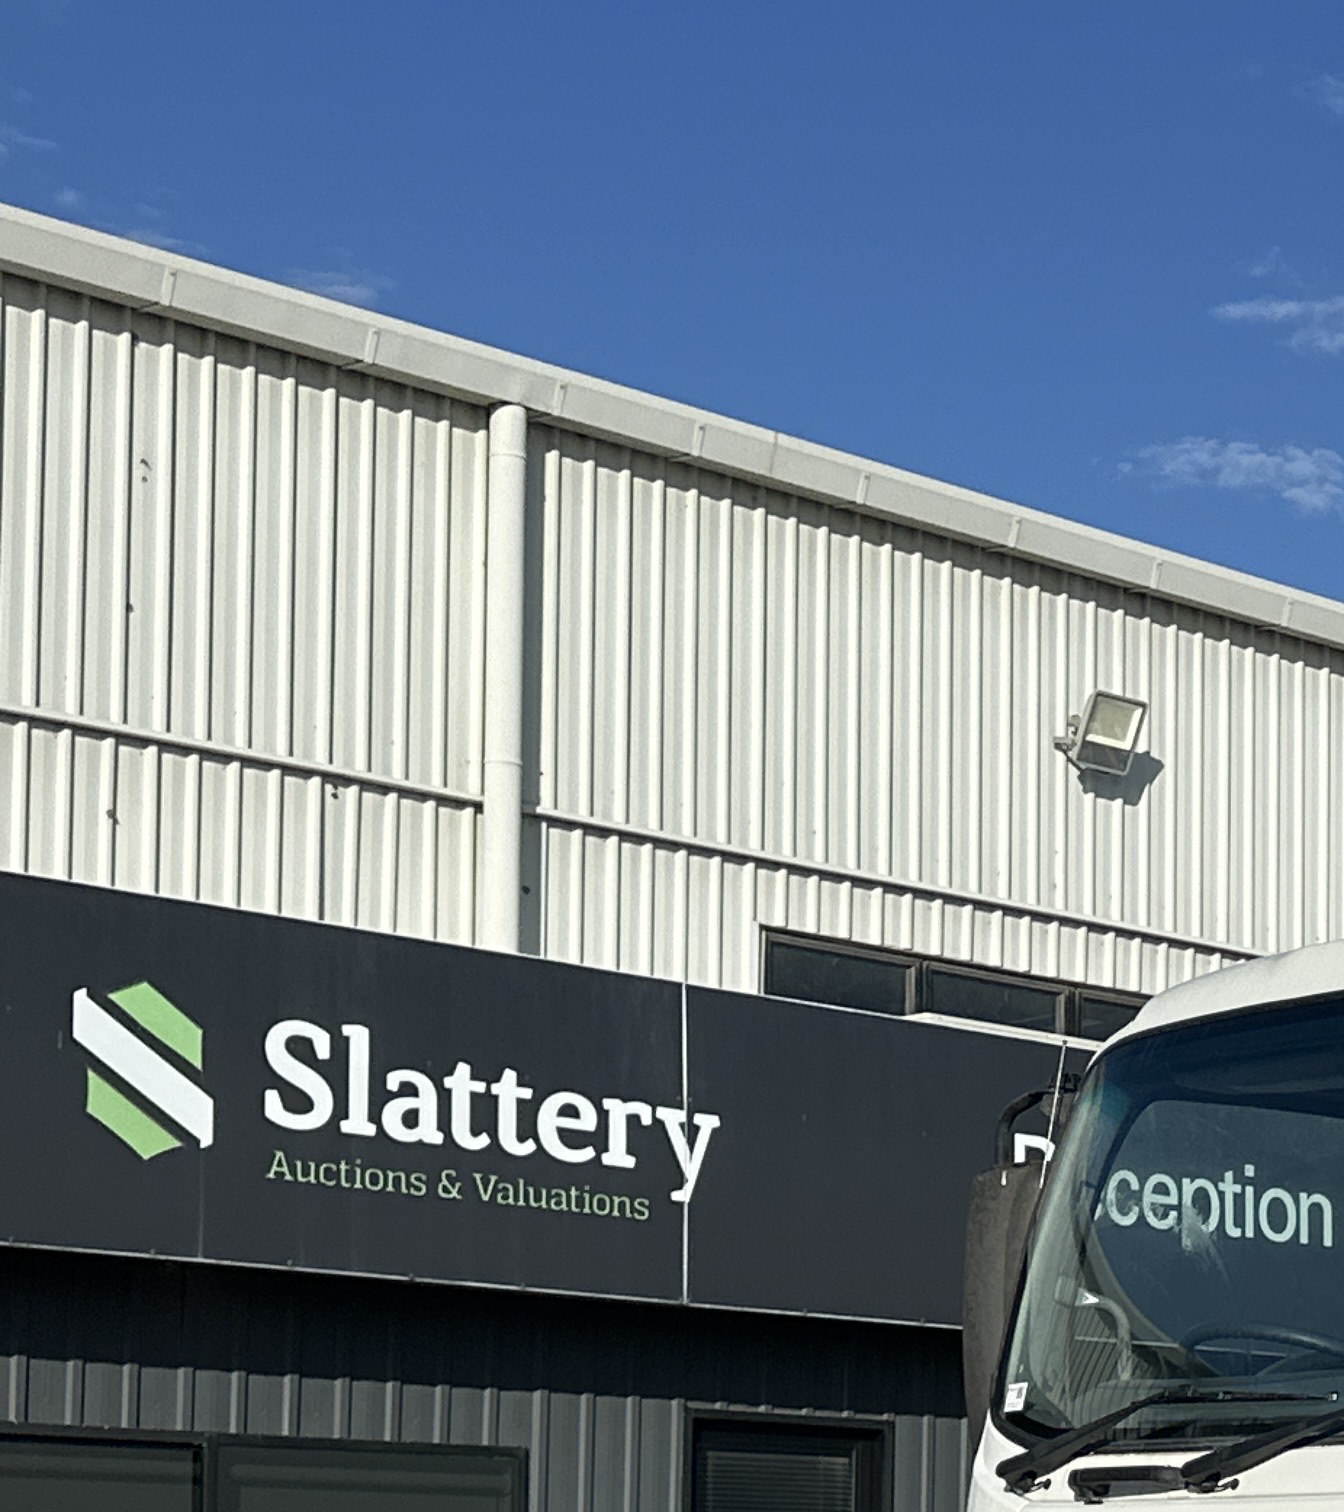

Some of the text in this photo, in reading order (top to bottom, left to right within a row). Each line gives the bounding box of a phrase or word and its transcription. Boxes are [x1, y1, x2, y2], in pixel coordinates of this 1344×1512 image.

[262, 1018, 721, 1203] Slattery
[266, 1150, 650, 1221] Auctions & Valuations
